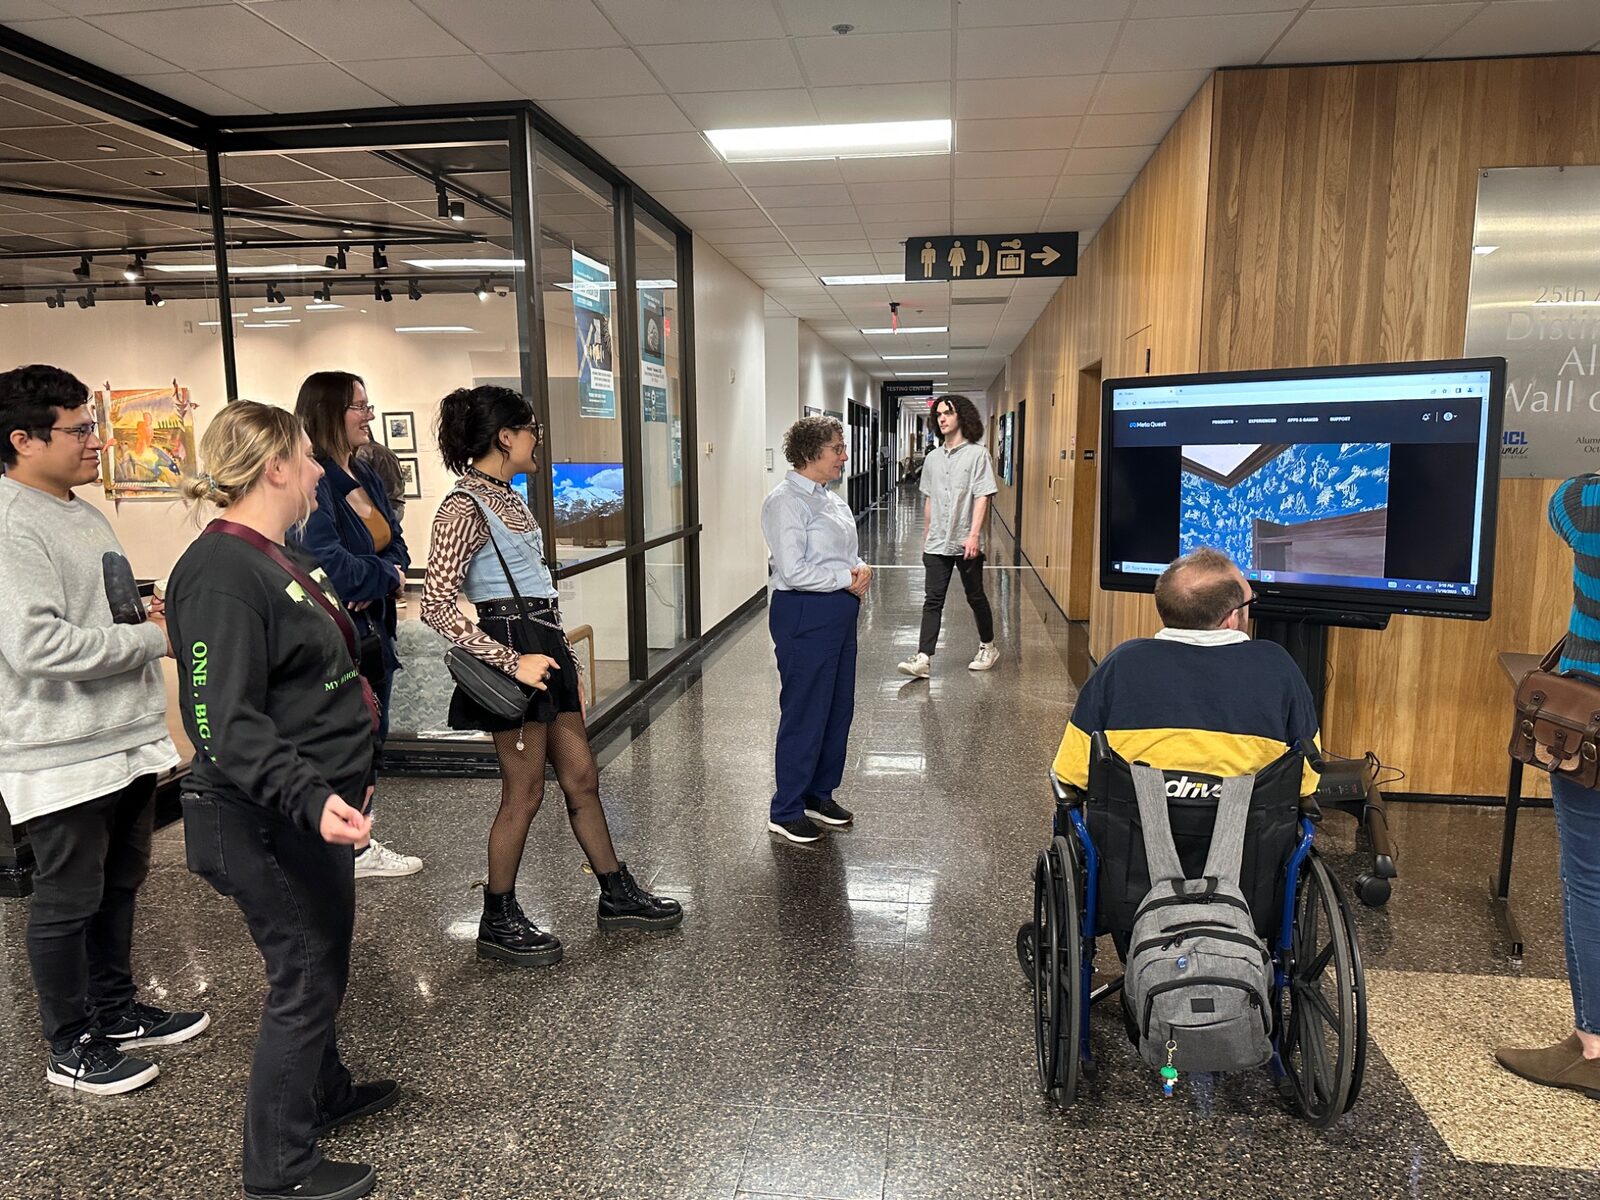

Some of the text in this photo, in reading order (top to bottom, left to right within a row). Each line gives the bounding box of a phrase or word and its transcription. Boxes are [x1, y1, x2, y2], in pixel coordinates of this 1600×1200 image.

[1535, 285, 1586, 304] 25th
[1505, 379, 1575, 413] Wall
[1150, 420, 1167, 428] Quest
[192, 641, 208, 687] ONE
[324, 679, 340, 692] MY
[194, 703, 211, 740] BIG
